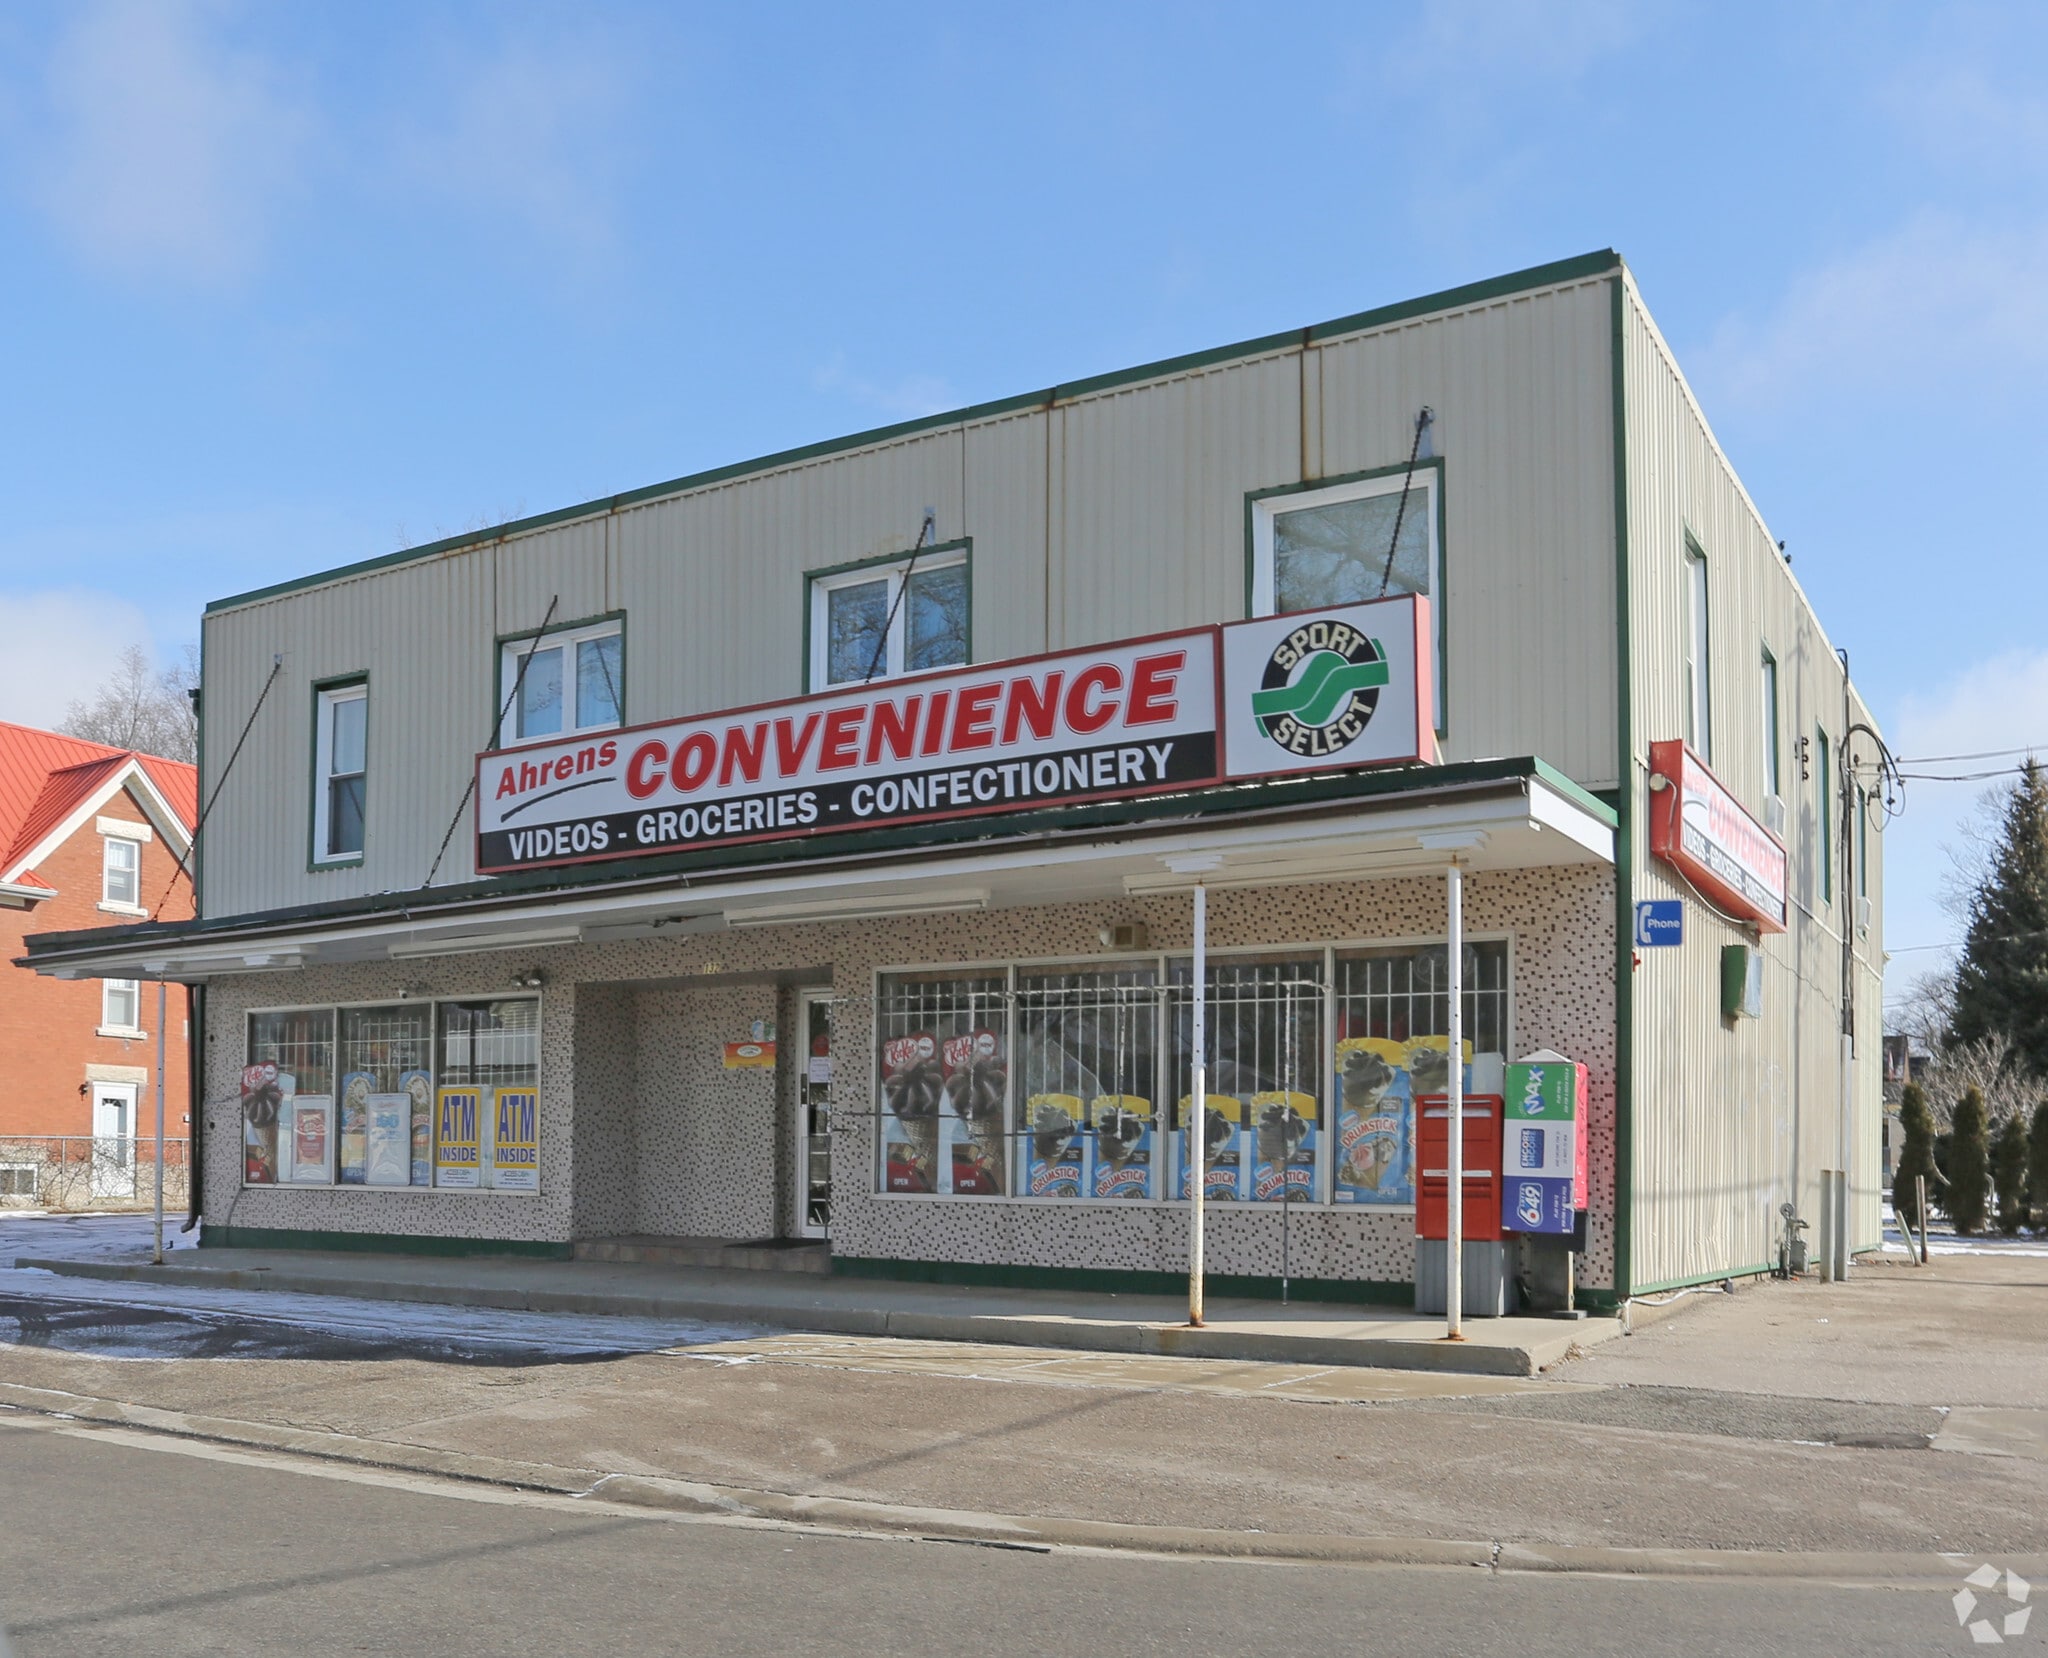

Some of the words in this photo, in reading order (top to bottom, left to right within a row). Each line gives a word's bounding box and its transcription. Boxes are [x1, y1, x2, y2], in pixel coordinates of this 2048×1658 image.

[1273, 622, 1367, 671] SPORT
[496, 740, 618, 801] Ahrens
[624, 648, 1188, 801] CONVENIENCE
[1273, 695, 1373, 755] SELECT
[508, 820, 609, 861] VIDEOS
[636, 791, 819, 844] GROCERIES
[851, 742, 1175, 817] CONFECTIONERY
[1647, 918, 1681, 928] Phone
[1524, 1069, 1545, 1115] MAX
[440, 1095, 476, 1142] ATM
[497, 1094, 535, 1143] ATM
[1341, 1118, 1397, 1148] DRUMSTICK
[440, 1147, 477, 1162] INSIDE
[496, 1148, 536, 1163] INSIDE
[1521, 1130, 1529, 1167] ENCORE
[1031, 1166, 1079, 1194] DRUMSTICK
[1096, 1169, 1146, 1197] DRUMSTICK
[1256, 1170, 1310, 1199] DRUMTICK
